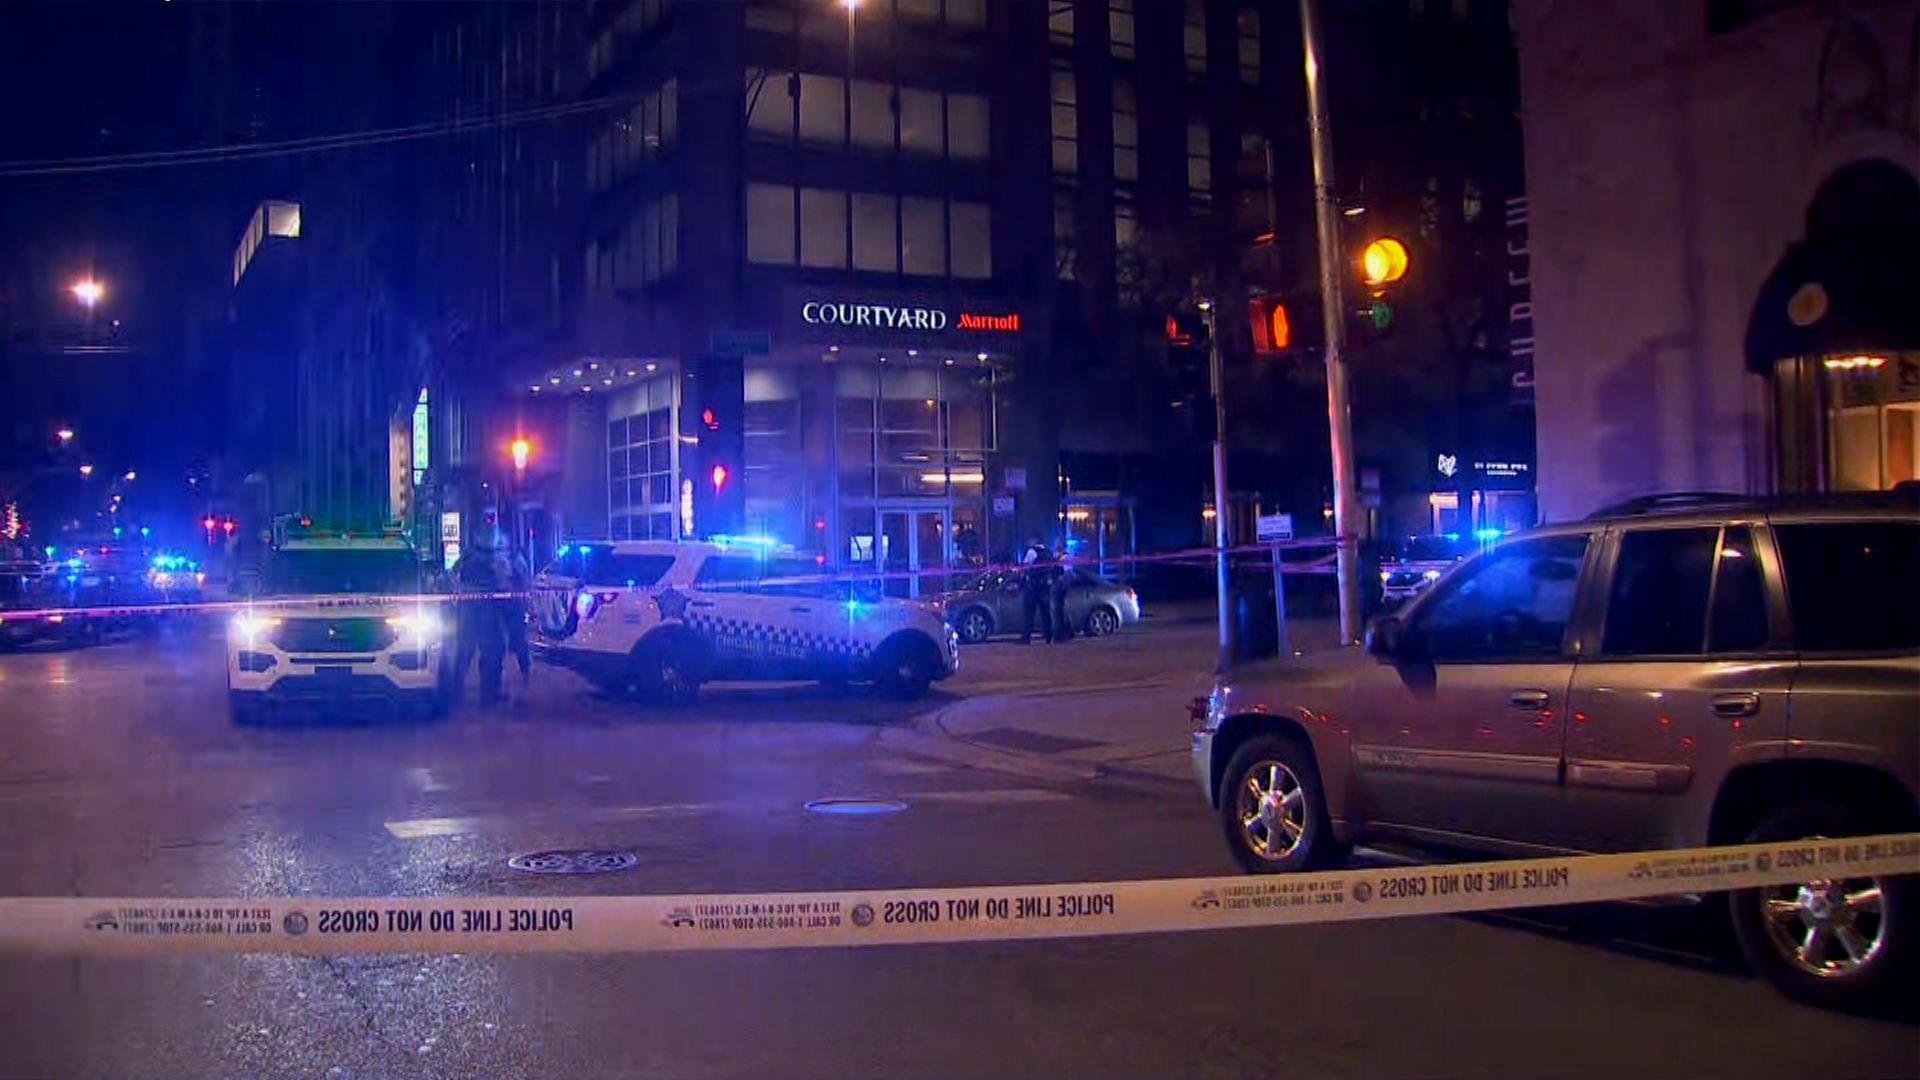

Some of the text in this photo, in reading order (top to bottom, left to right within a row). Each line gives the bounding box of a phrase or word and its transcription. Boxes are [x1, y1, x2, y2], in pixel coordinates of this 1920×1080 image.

[802, 302, 1019, 331] COURTYARD Marriott
[715, 634, 806, 657] CHICAGO POLICE
